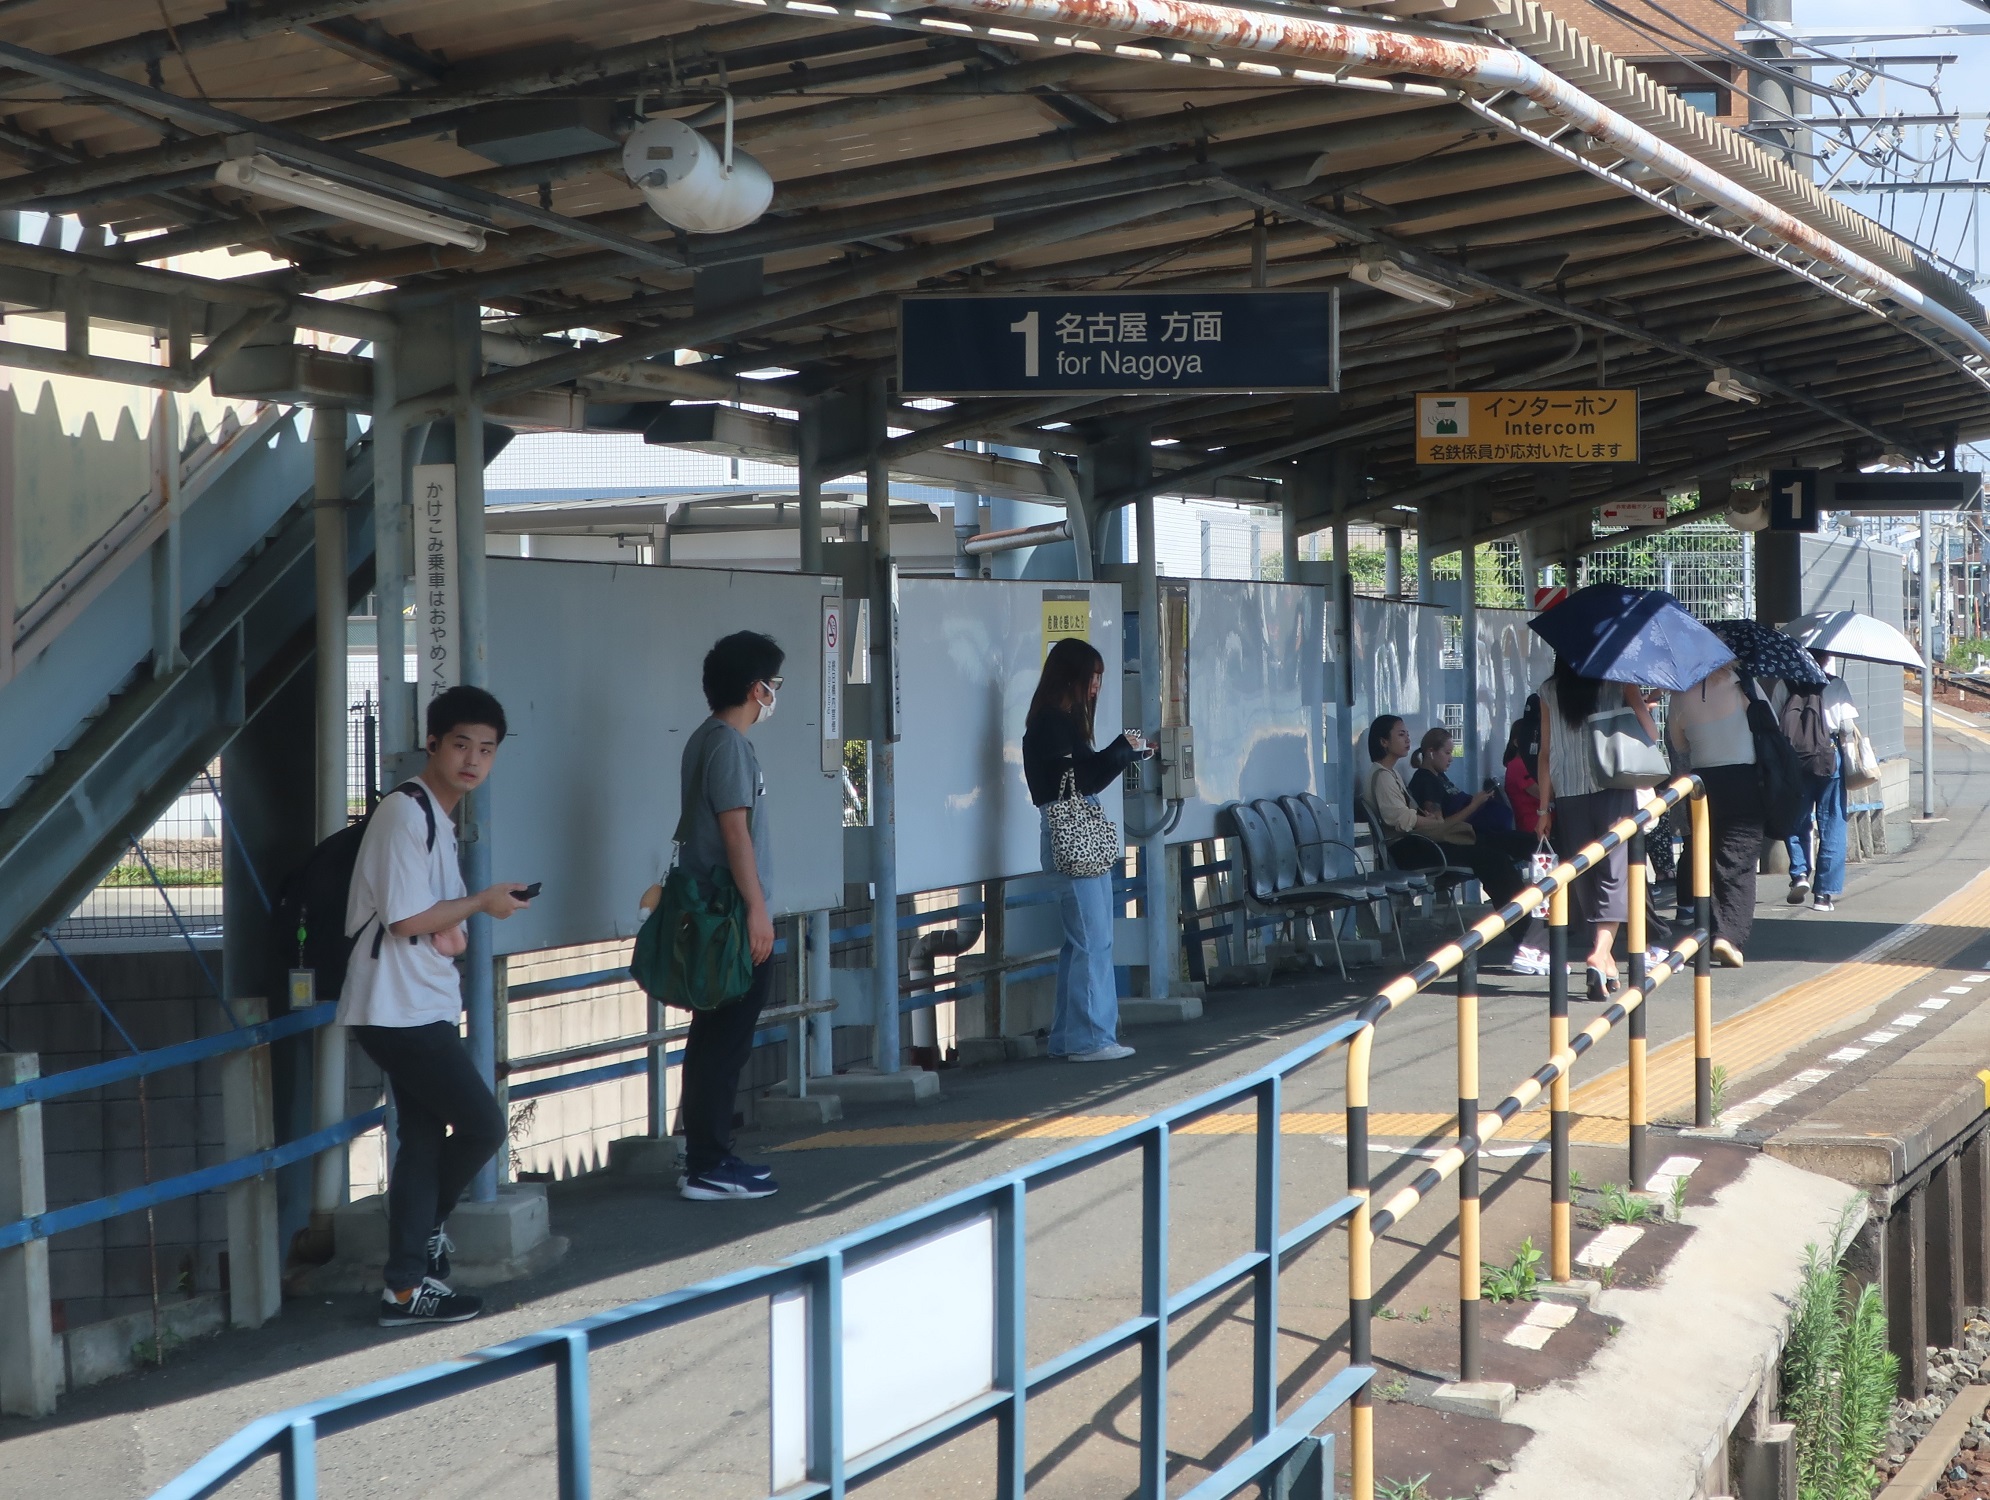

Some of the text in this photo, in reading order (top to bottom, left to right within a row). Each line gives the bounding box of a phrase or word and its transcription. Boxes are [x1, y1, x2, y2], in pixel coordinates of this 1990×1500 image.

[1055, 310, 1223, 344] 名古屋 方面
[1010, 311, 1039, 377] 1
[1056, 350, 1203, 380] for Nagoya
[1484, 396, 1618, 418] インターホン
[1505, 420, 1595, 436] Intercom
[1429, 442, 1622, 461] 名鉄係員が応対いたします
[1781, 481, 1802, 520] 1
[426, 481, 448, 697] かけこみ乗車はおやめくだ
[1047, 614, 1085, 630] 危険を感じたら
[415, 1296, 440, 1316] N
